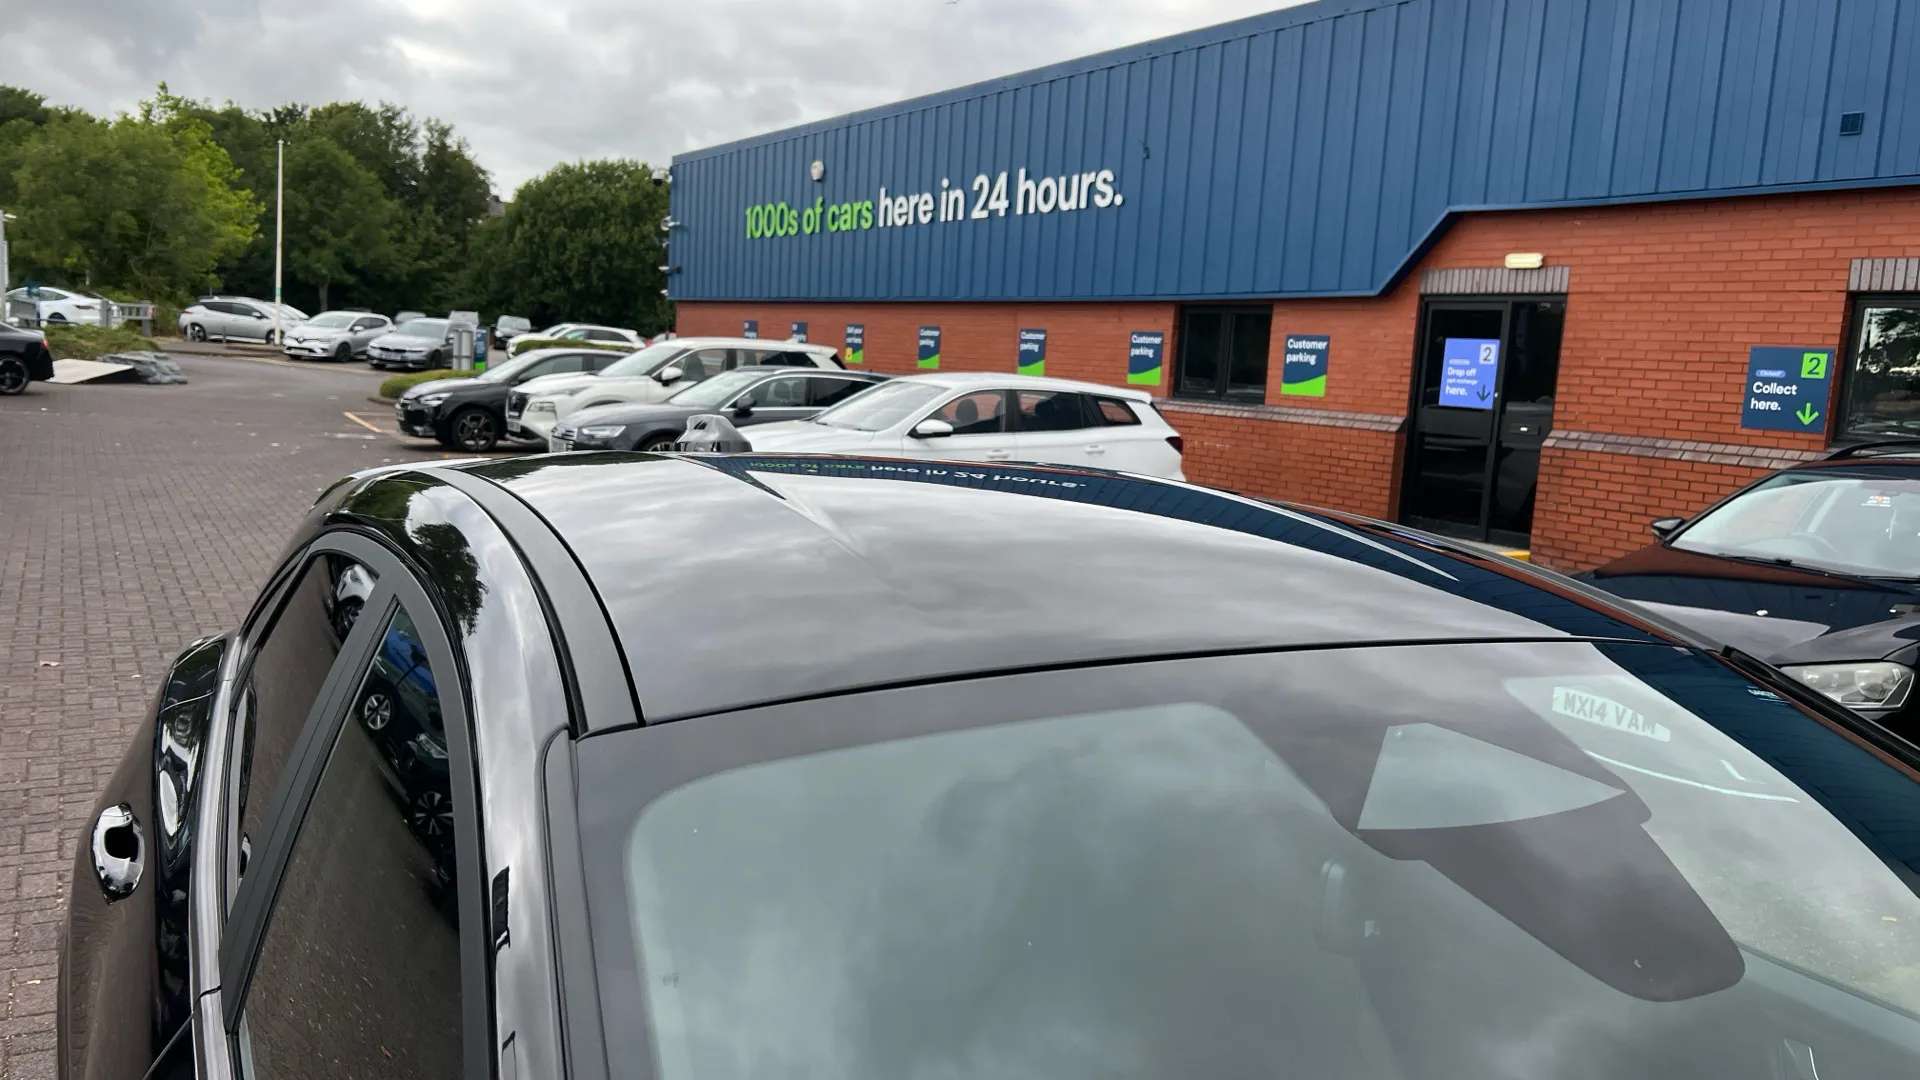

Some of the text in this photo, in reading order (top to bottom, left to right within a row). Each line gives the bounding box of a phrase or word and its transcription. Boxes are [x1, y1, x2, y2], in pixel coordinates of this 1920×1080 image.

[745, 167, 1123, 239] 1000s of cars here in 24 hours.
[1287, 338, 1329, 350] Customer
[1285, 351, 1316, 365] parking
[1483, 346, 1492, 362] 2
[1807, 357, 1821, 375] 2
[1752, 381, 1798, 395] Collect
[1750, 397, 1781, 411] here.
[1564, 691, 1608, 722] MX14
